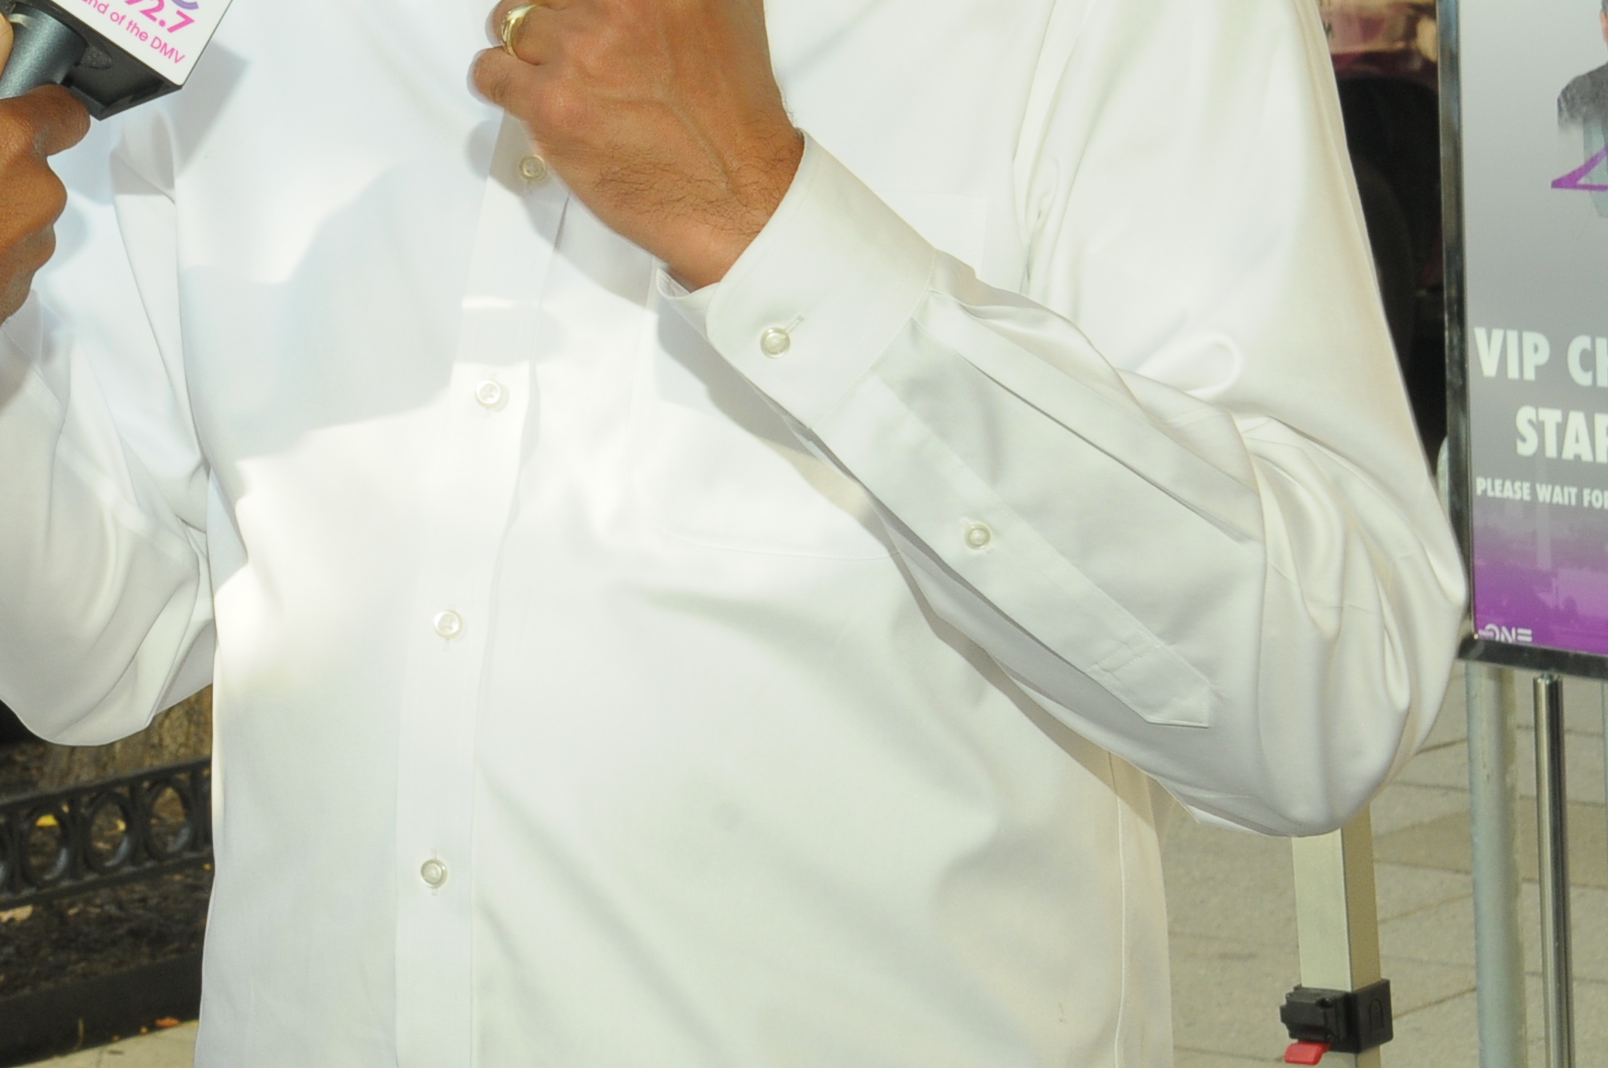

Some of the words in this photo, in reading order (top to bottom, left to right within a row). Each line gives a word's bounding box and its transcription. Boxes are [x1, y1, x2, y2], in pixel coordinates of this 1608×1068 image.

[109, 7, 127, 25] of
[127, 20, 149, 42] the
[150, 36, 186, 64] DMV
[1474, 326, 1550, 381] VIP
[1476, 476, 1531, 502] PLEASE
[1536, 483, 1578, 506] WAIT
